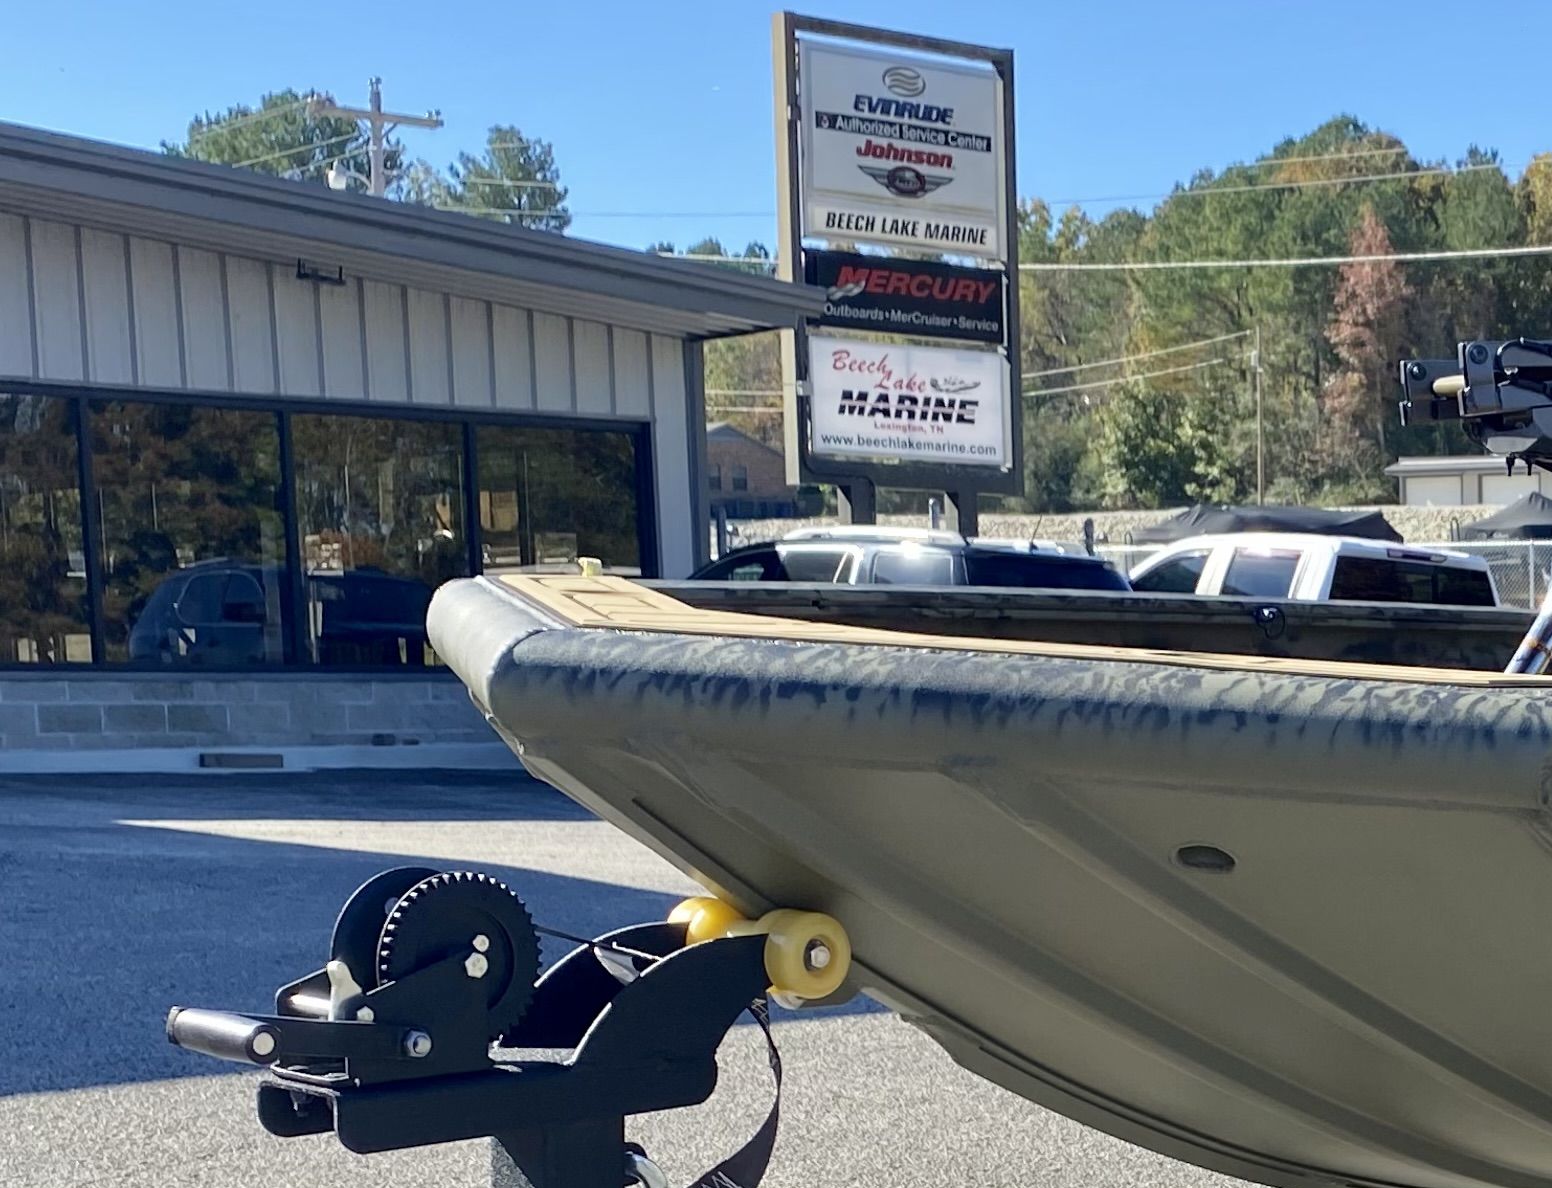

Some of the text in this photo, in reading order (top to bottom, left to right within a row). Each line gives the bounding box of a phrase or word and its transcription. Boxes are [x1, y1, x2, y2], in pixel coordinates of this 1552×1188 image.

[853, 94, 954, 126] EVINRUDE
[835, 114, 988, 151] Authorized Service Center
[856, 139, 953, 169] Johnson
[825, 211, 988, 245] BEECH LAKE MARINE
[836, 266, 996, 304] MERCURY
[832, 349, 888, 375] Beech
[873, 370, 926, 393] Lake
[838, 390, 979, 425] MARINE
[821, 433, 997, 456] www.beechlakemarine.com
